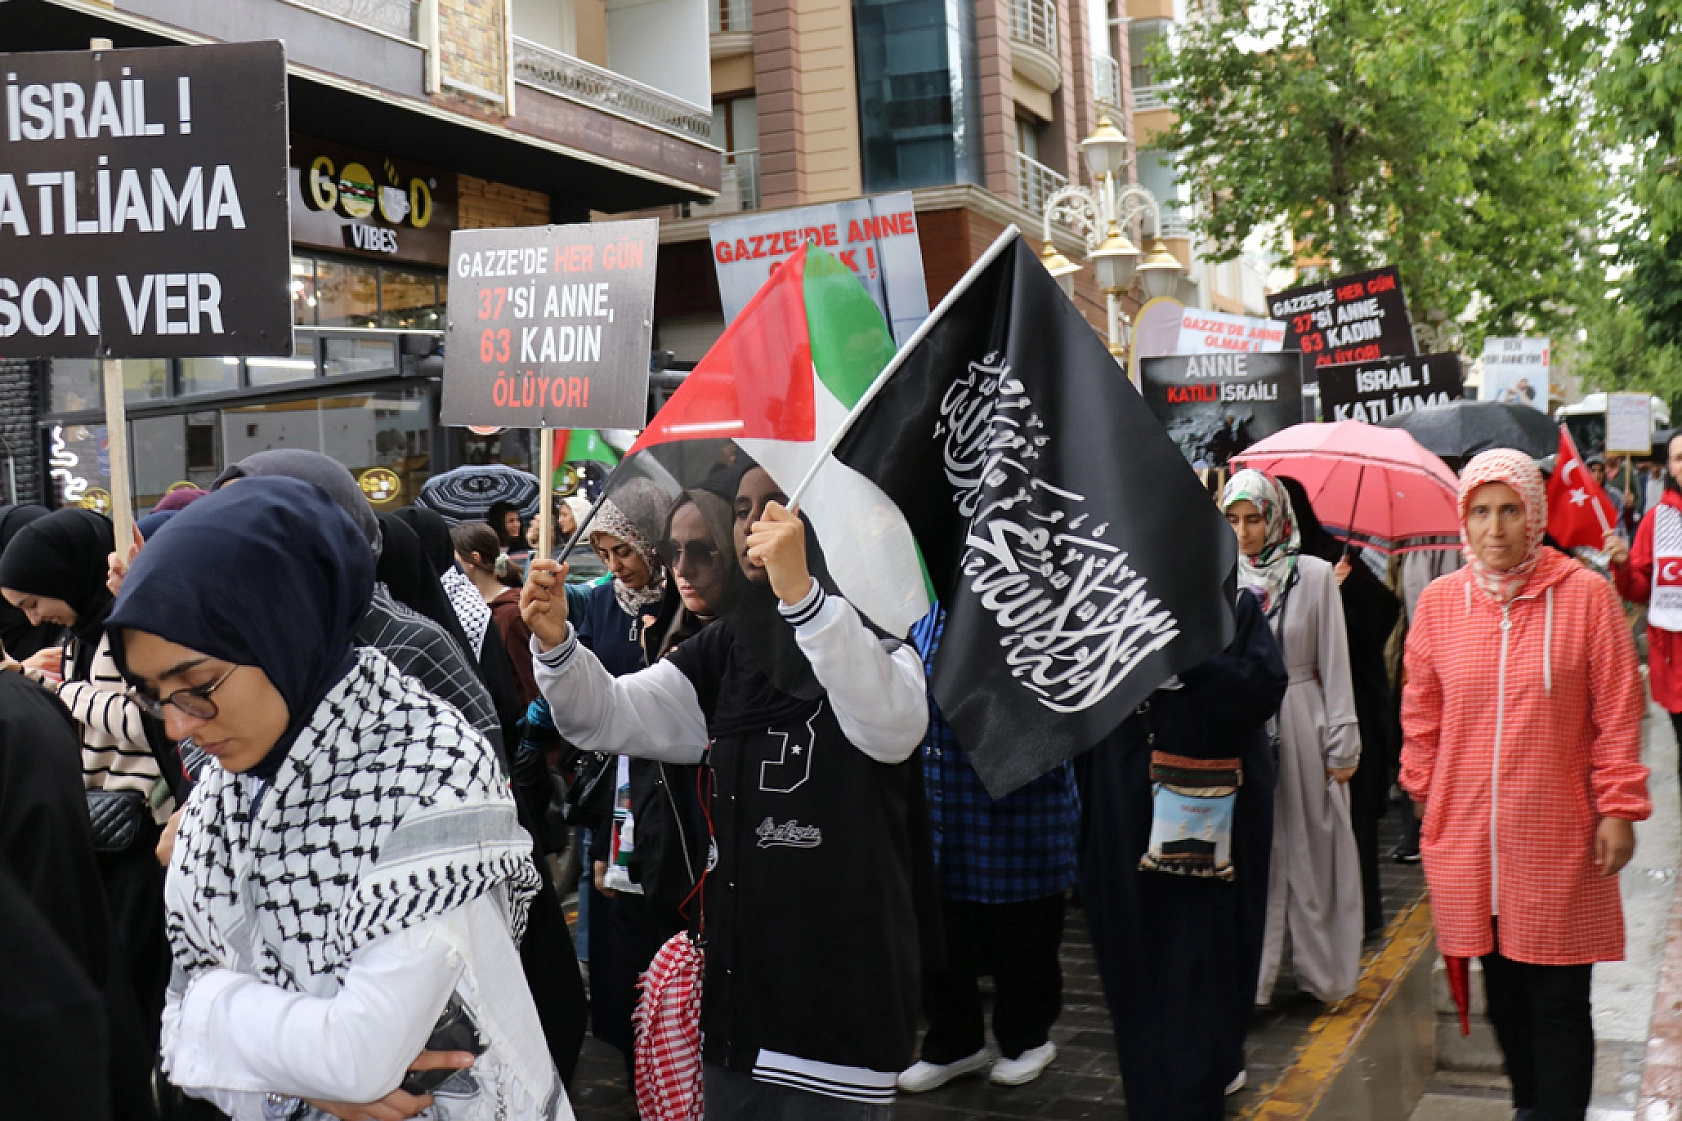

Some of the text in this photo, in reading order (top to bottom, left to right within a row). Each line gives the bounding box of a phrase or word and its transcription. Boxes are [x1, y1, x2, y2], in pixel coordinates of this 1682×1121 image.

[6, 66, 192, 141] İSRAİL !
[352, 224, 398, 254] VIBES
[716, 211, 915, 264] GAZZE'DE ANNE
[457, 236, 645, 278] GAZZE'DE HER GÜN
[867, 247, 877, 279] !
[115, 272, 225, 336] VER
[478, 278, 614, 323] 37'Sİ ANNE,
[1272, 273, 1396, 317] GAZZE'DE HER GÜN
[1182, 316, 1284, 342] GAZZE'DE ANNE
[1292, 296, 1385, 334] 37'Sİ ANNE,
[479, 324, 602, 364] 63 KADIN
[1204, 334, 1250, 353] OLMAK
[1300, 318, 1382, 354] 63 KADIN
[1185, 354, 1248, 379] ANNE
[1355, 362, 1420, 395] İSRAİL
[492, 370, 590, 408] ÖLÜYOR!
[1166, 379, 1278, 403] KATİLİ İSRAİL!
